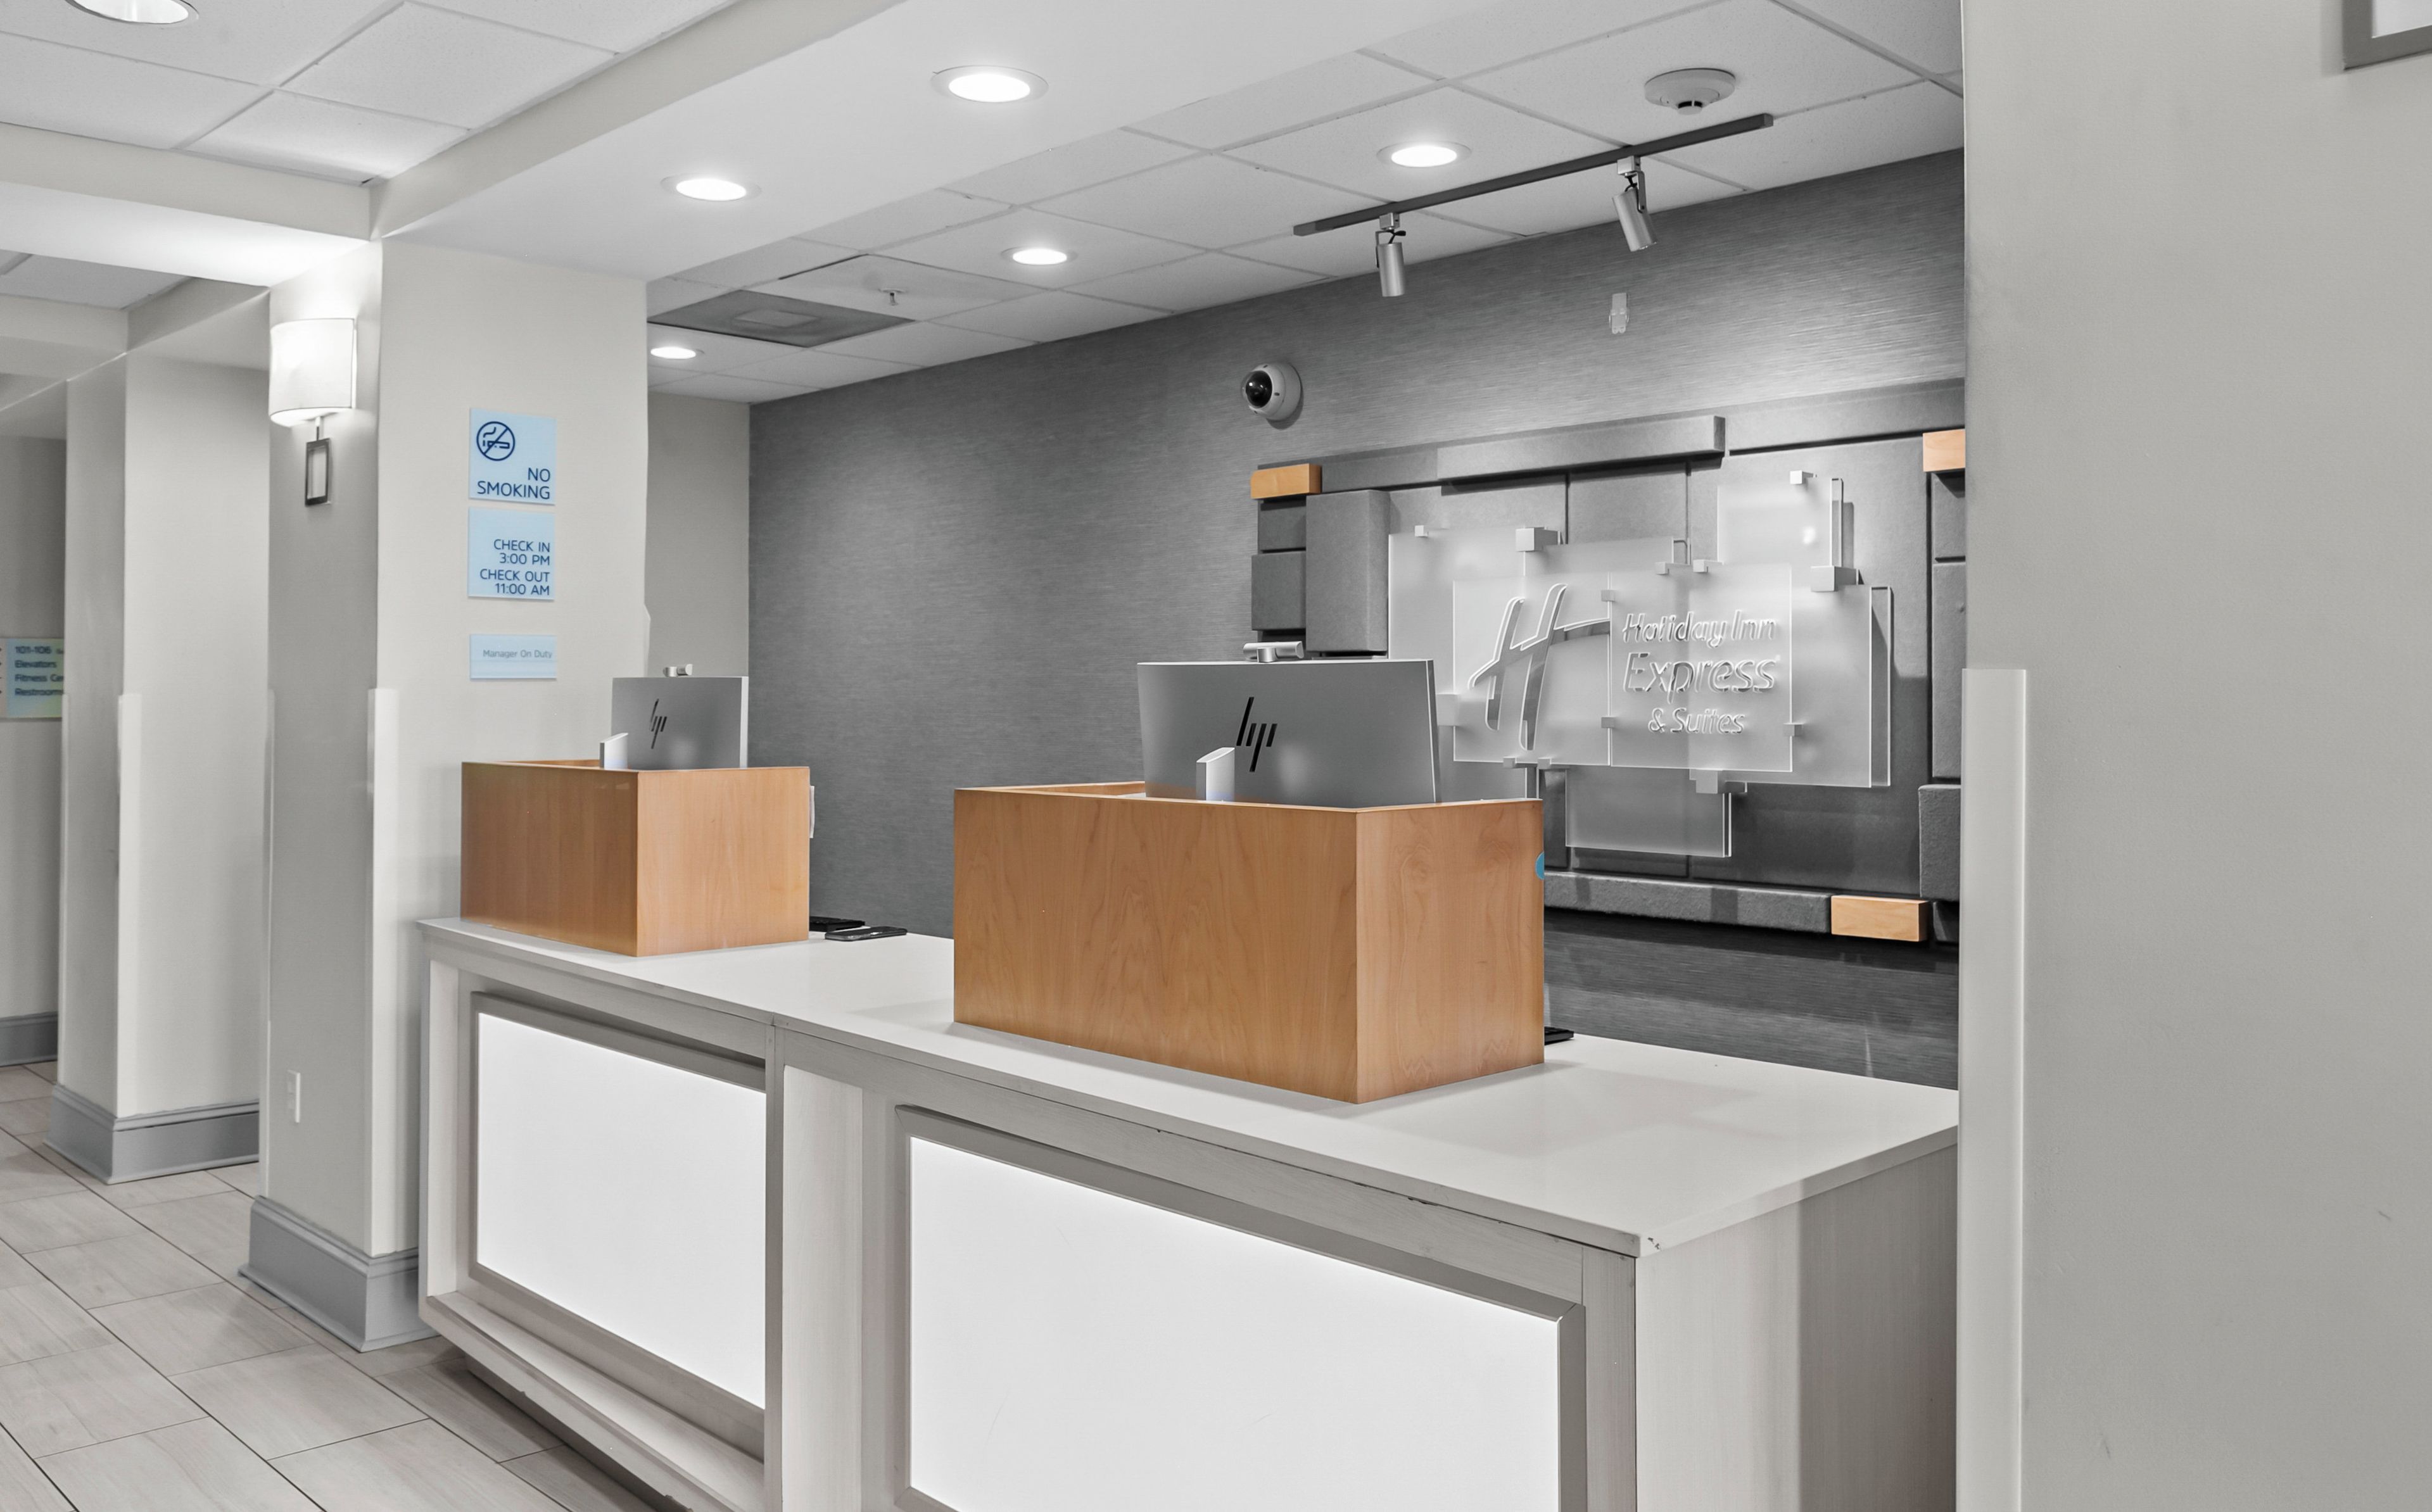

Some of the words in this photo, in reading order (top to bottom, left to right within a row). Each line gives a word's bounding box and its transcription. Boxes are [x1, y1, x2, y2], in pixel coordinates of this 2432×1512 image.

[528, 467, 551, 482] NO
[477, 481, 550, 500] SMOKING
[493, 539, 533, 551] CHECK
[538, 542, 550, 552] IN
[499, 553, 527, 565] 3:00
[532, 555, 550, 565] PM
[479, 569, 520, 581] CHECK
[524, 570, 550, 582] OUT
[495, 583, 526, 595] 11:00
[530, 584, 550, 596] AM
[1622, 611, 1727, 649] Holiday
[1731, 609, 1776, 641] Inn
[483, 649, 517, 658] Manager
[520, 650, 532, 658] On
[534, 650, 553, 659] Duty
[15, 660, 57, 669] Elevators
[15, 674, 48, 682] Fitness
[1623, 652, 1776, 705] Express
[1648, 707, 1666, 733] &
[1669, 707, 1746, 735] Suites
[1236, 696, 1278, 772] hp
